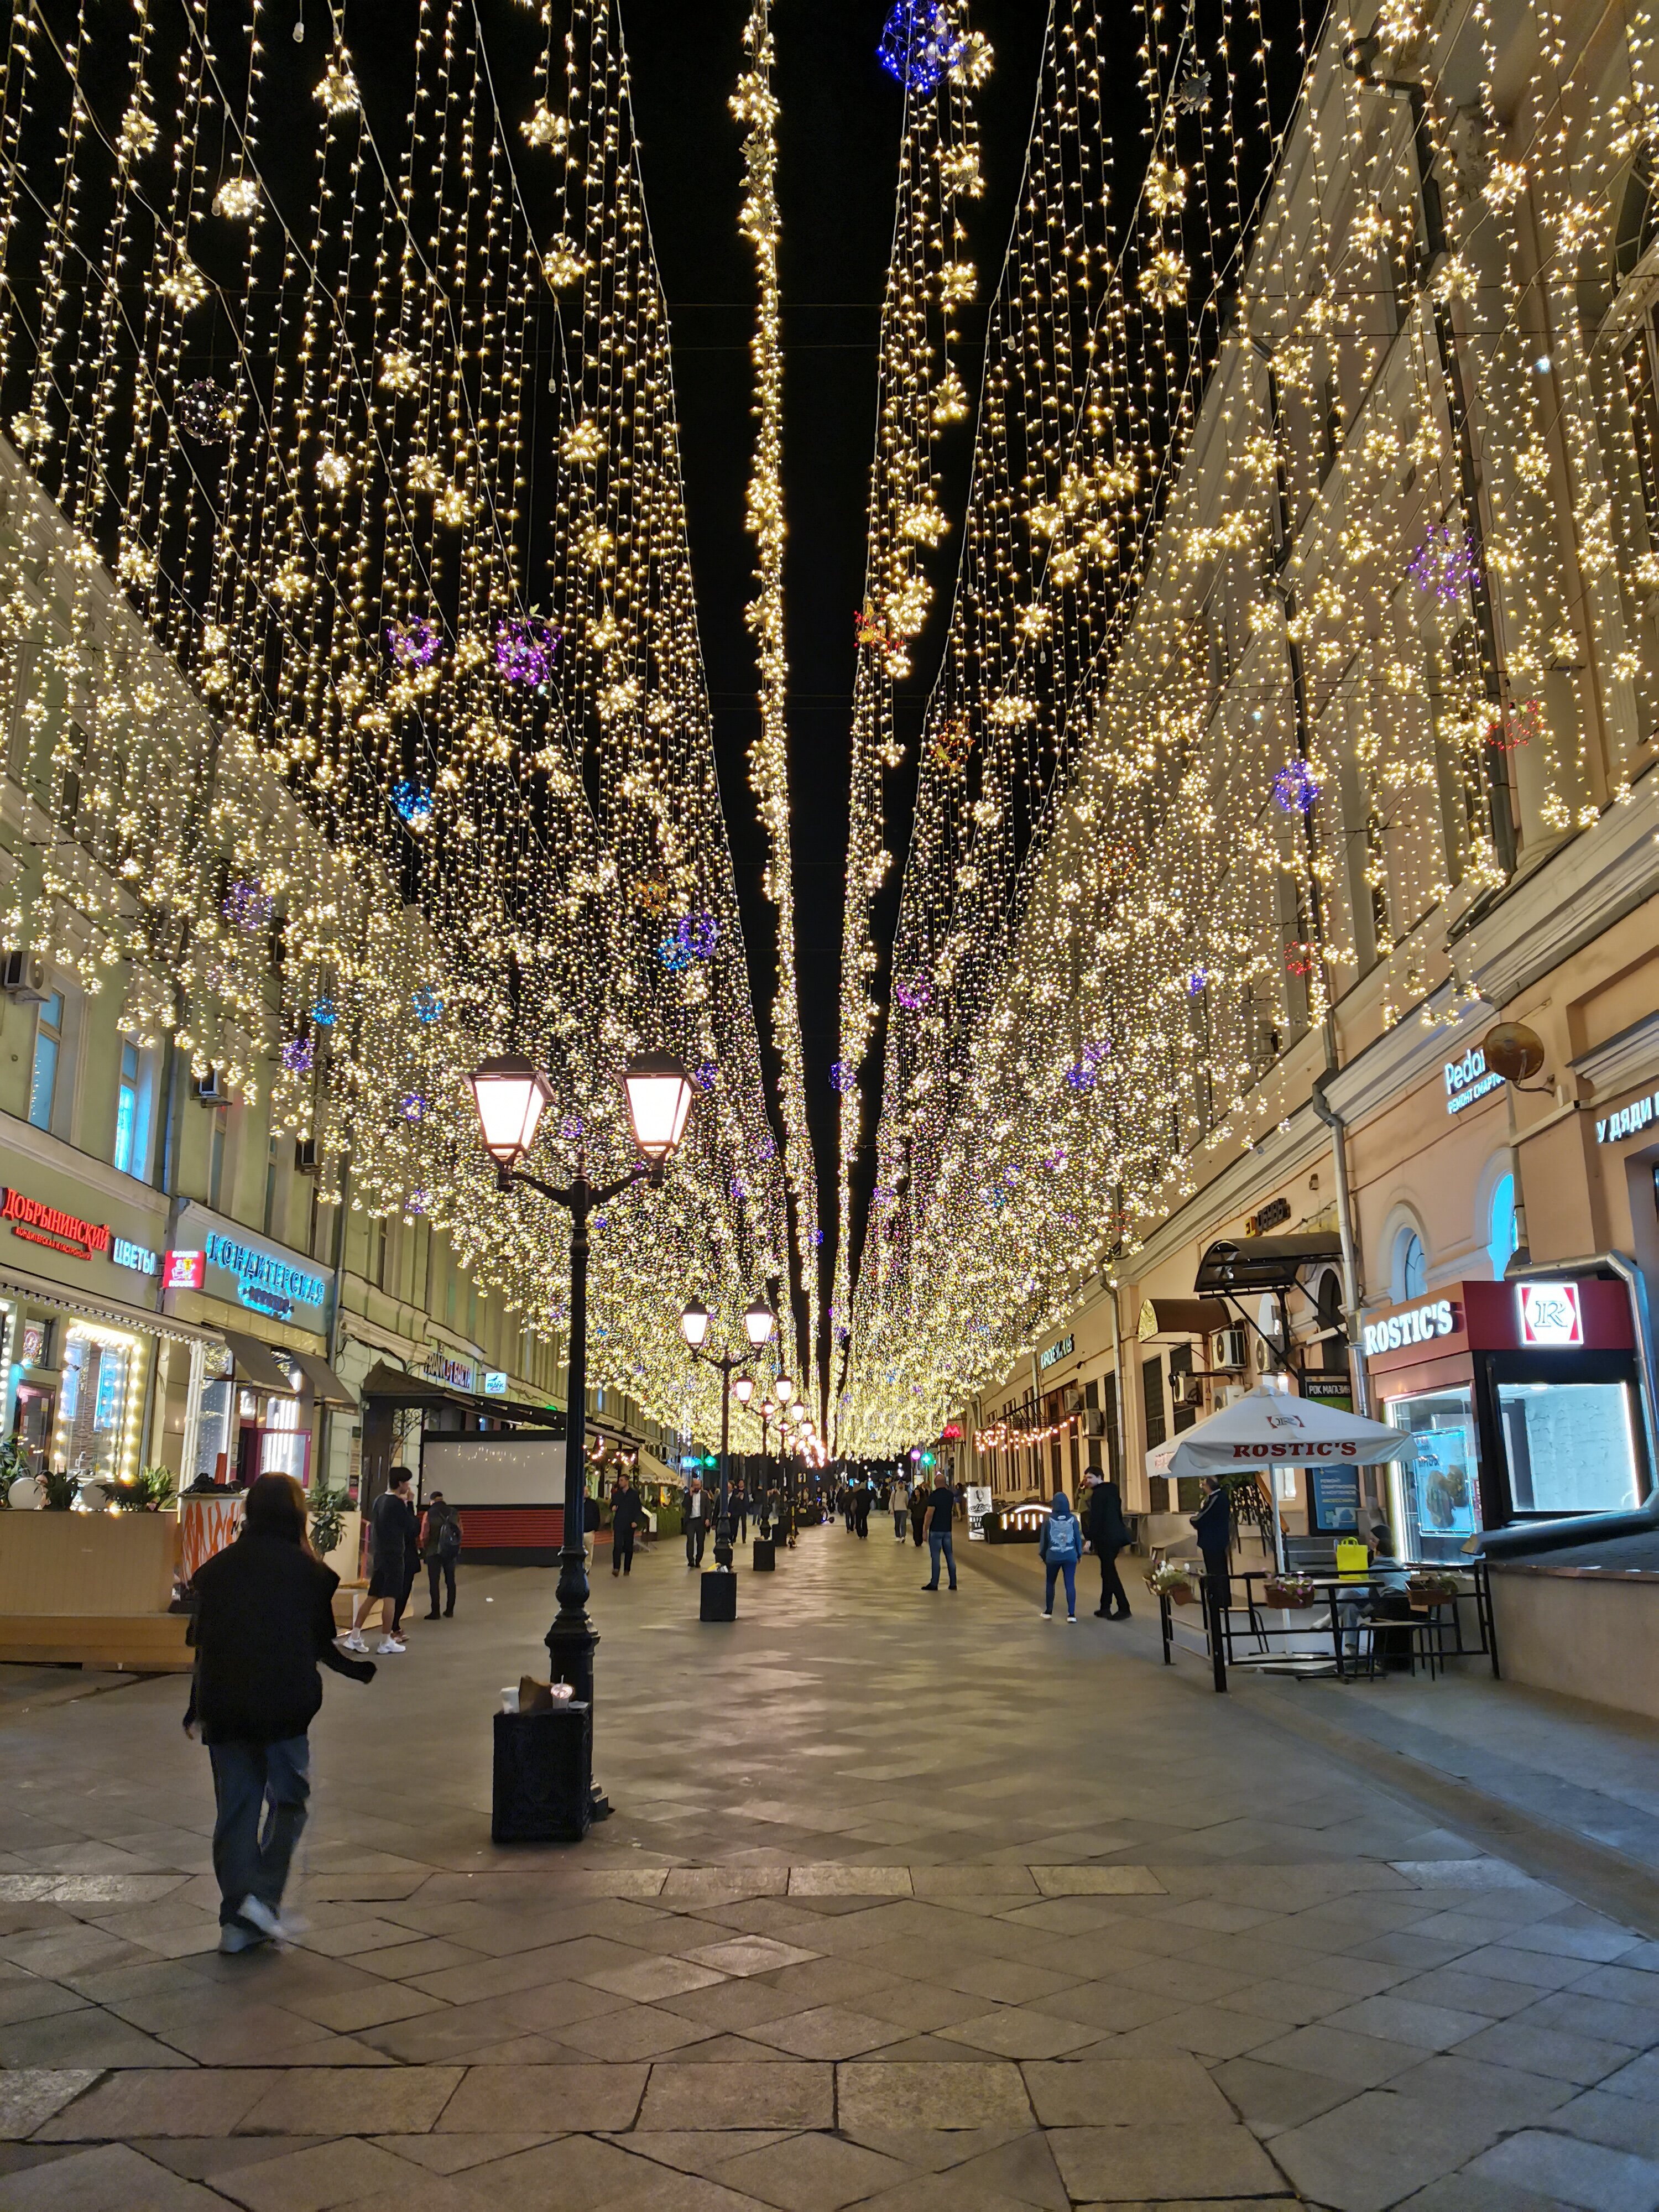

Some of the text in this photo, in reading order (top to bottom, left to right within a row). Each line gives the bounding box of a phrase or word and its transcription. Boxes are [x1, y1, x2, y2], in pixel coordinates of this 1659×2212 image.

[1444, 1048, 1485, 1095] Peda
[1447, 1088, 1473, 1114] РЕМОНТ
[1596, 1119, 1606, 1144] У
[1610, 1097, 1652, 1142] ДЯДИ
[2, 1188, 109, 1252] ДОБРЫНИНСКИЙ
[113, 1238, 155, 1275] ЦВЕТЫ
[207, 1234, 325, 1304] КОНДИТЕРСКАЯ
[1364, 1300, 1453, 1356] ROSTIC'S
[1308, 1385, 1351, 1395] РОК МАГАЗИН
[1233, 1442, 1357, 1458] ROSTIC'S
